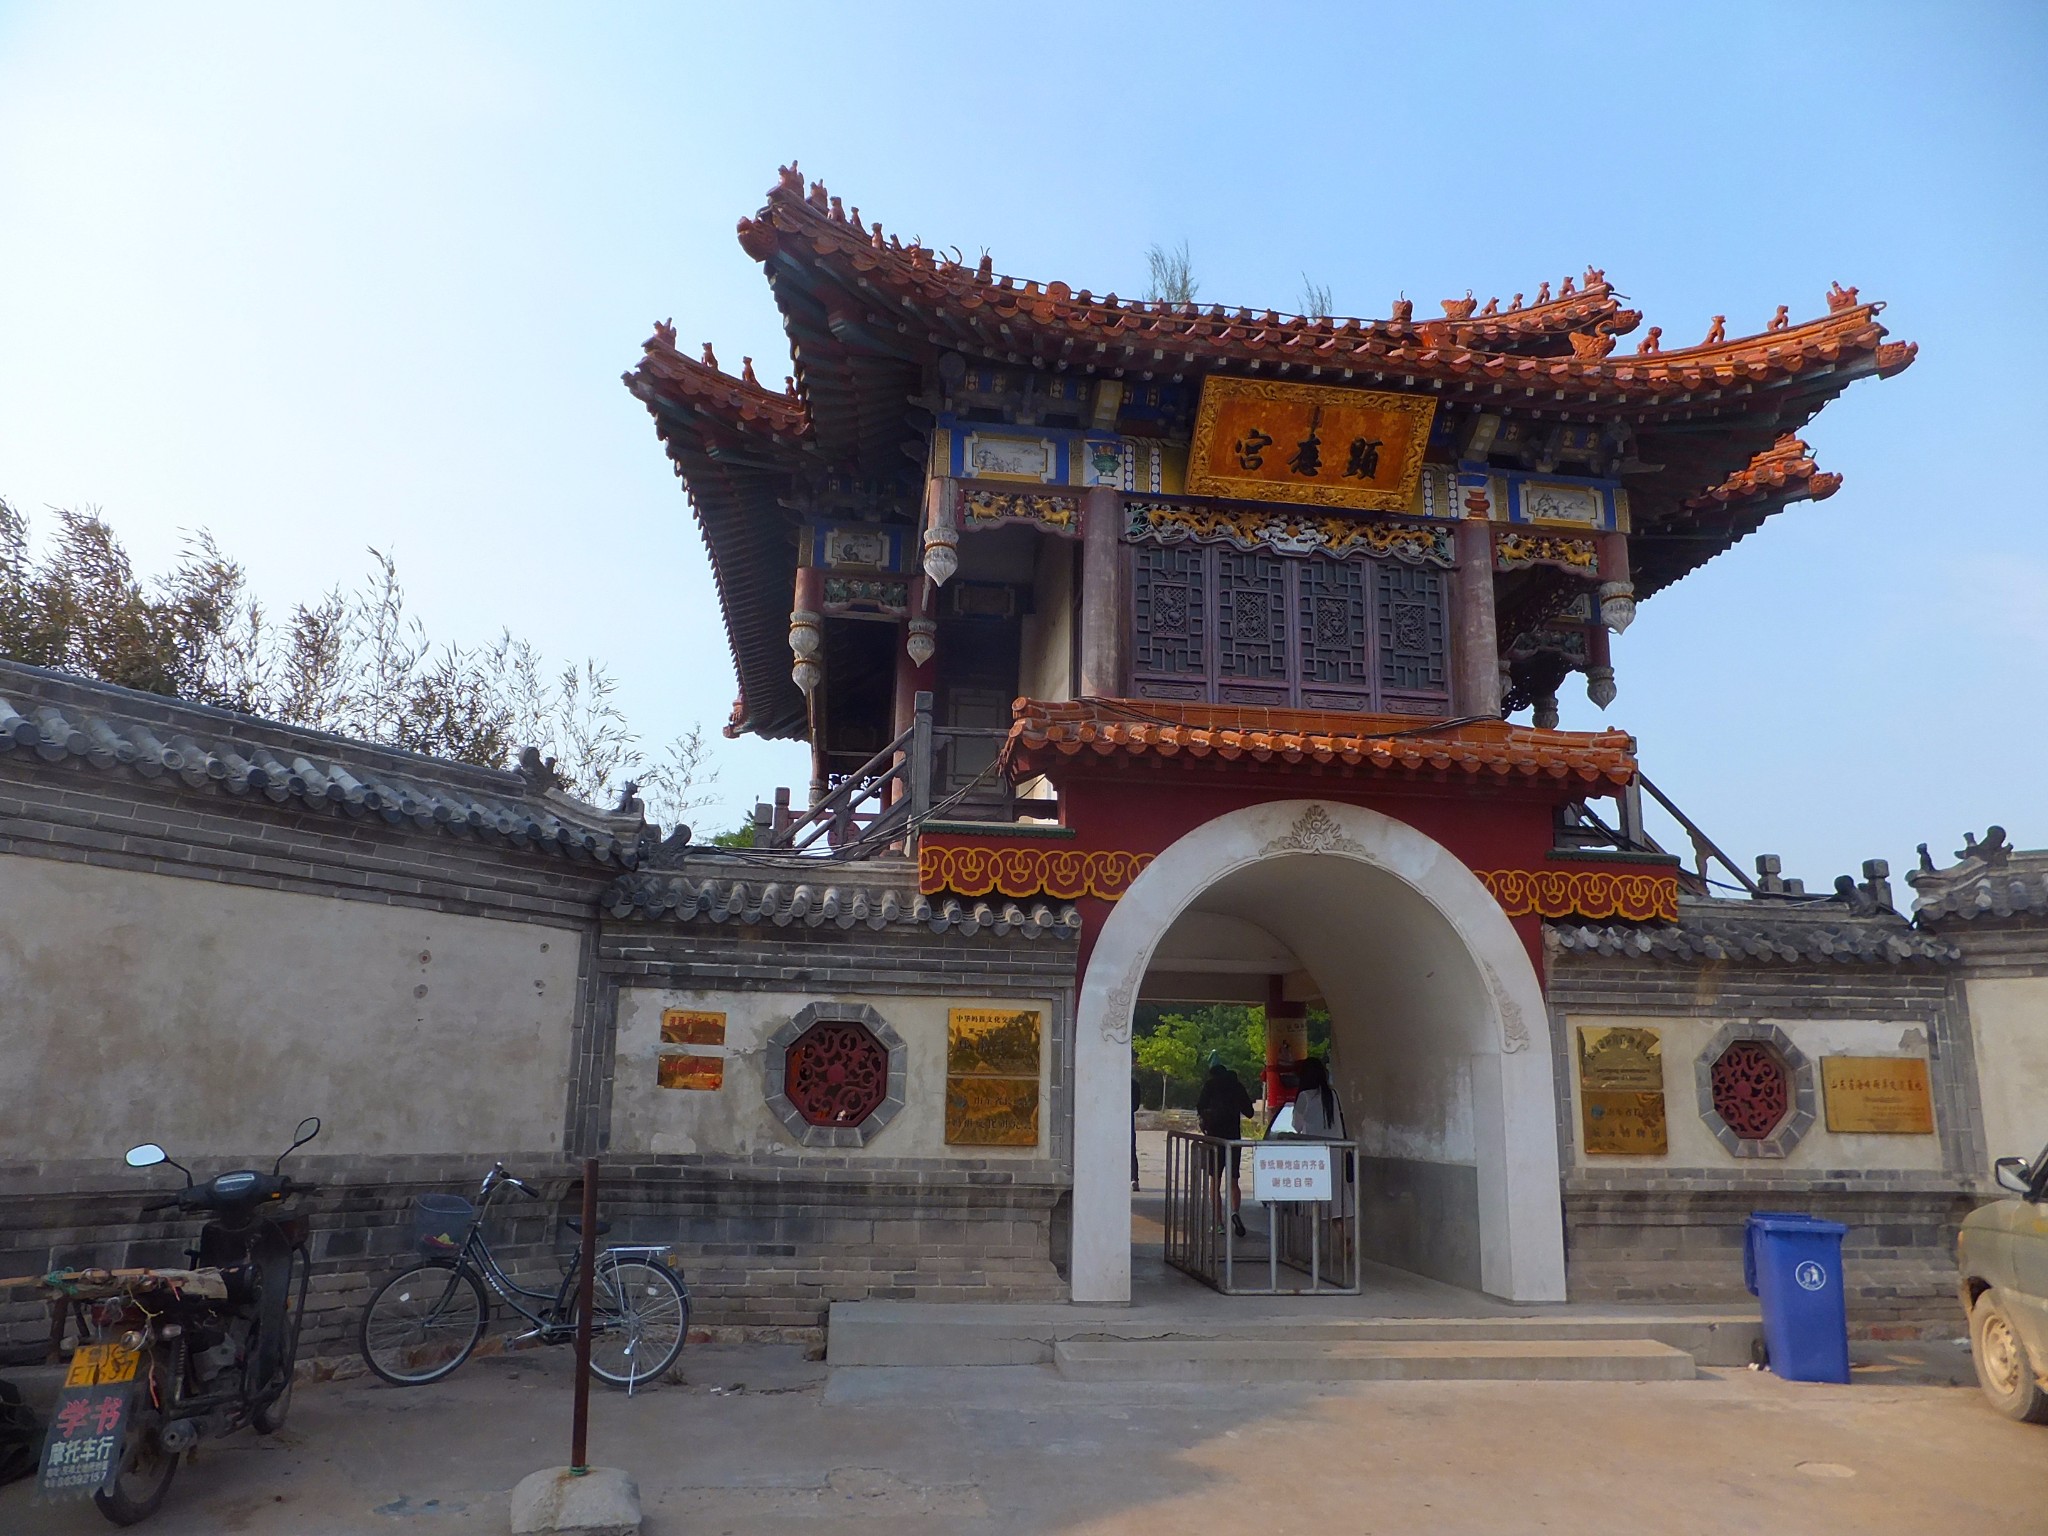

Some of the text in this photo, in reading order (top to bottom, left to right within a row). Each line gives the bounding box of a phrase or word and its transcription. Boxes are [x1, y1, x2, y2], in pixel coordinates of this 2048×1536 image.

[1272, 1177, 1314, 1188] 谢绝自带
[48, 1435, 115, 1466] 摩托车行
